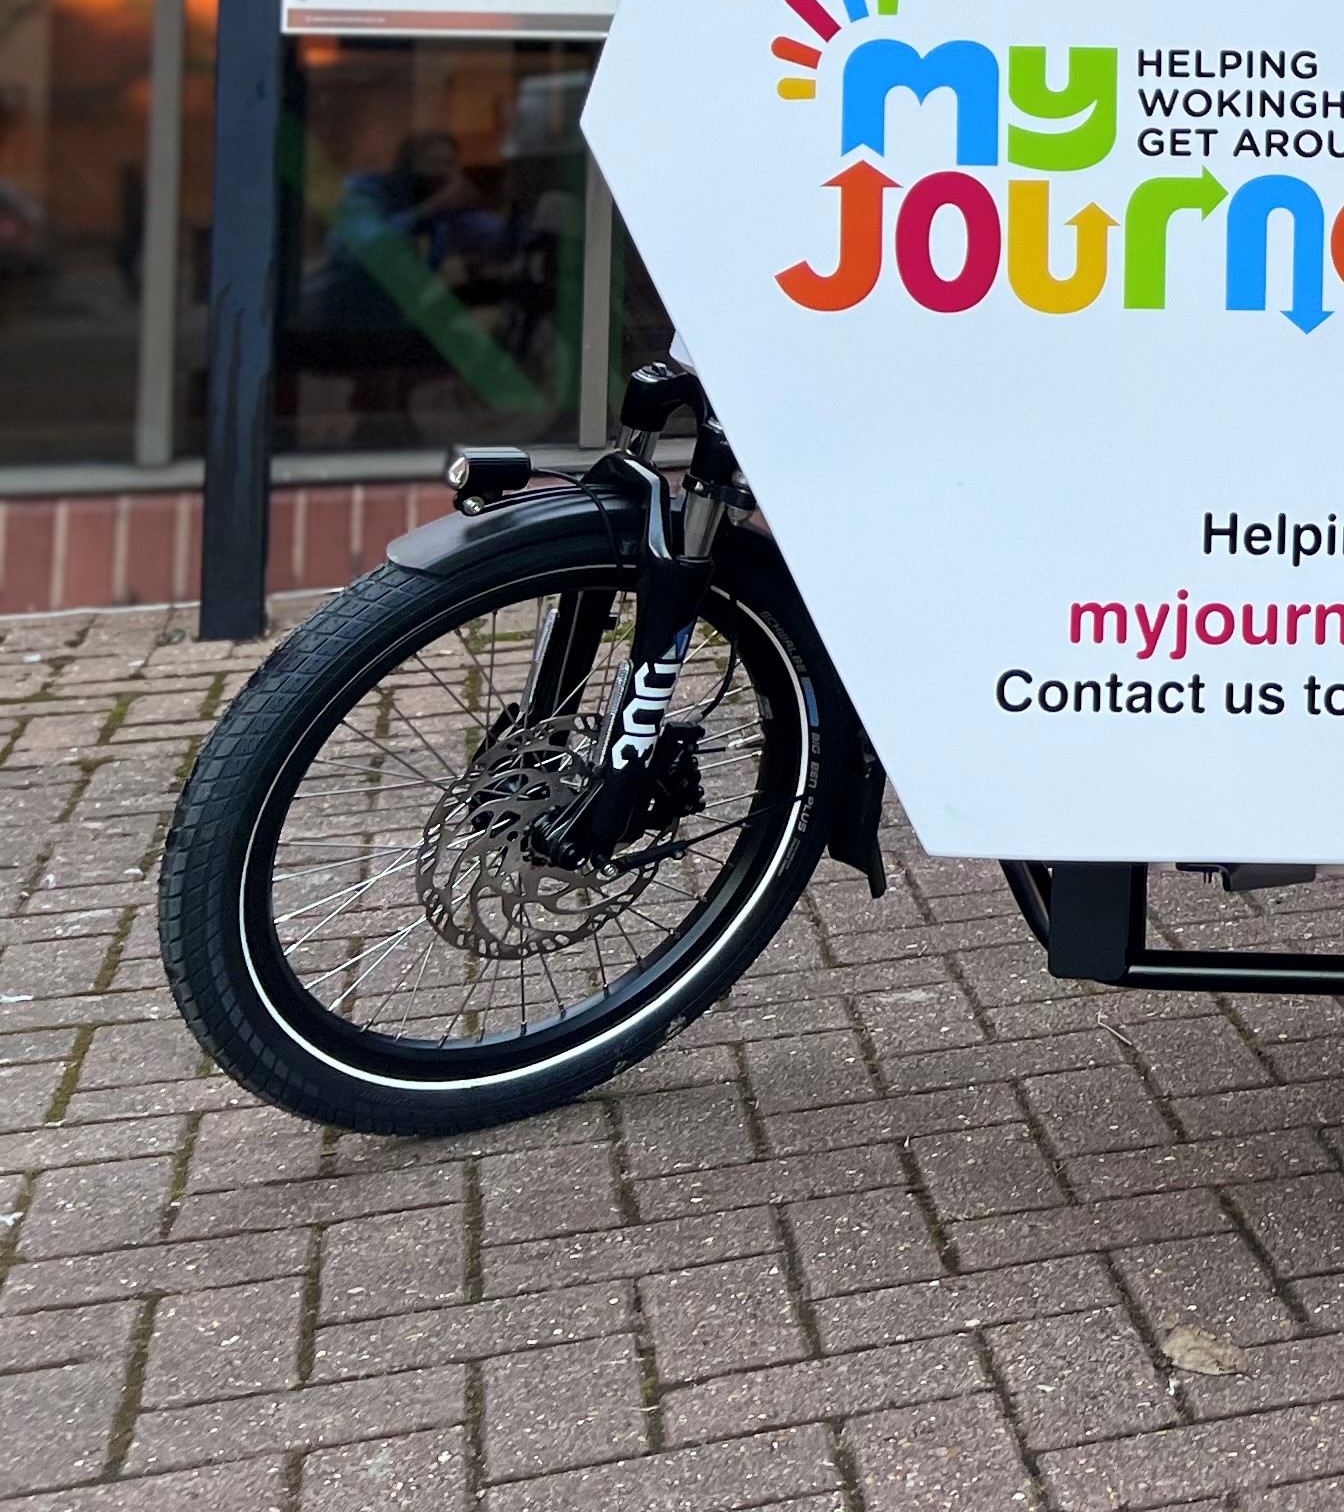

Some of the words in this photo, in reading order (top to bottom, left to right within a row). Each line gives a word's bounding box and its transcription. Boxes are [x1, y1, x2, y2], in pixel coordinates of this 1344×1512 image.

[1138, 48, 1319, 81] HELPING
[1138, 128, 1219, 158] GET
[995, 669, 1205, 715] Contact
[1225, 681, 1285, 717] us
